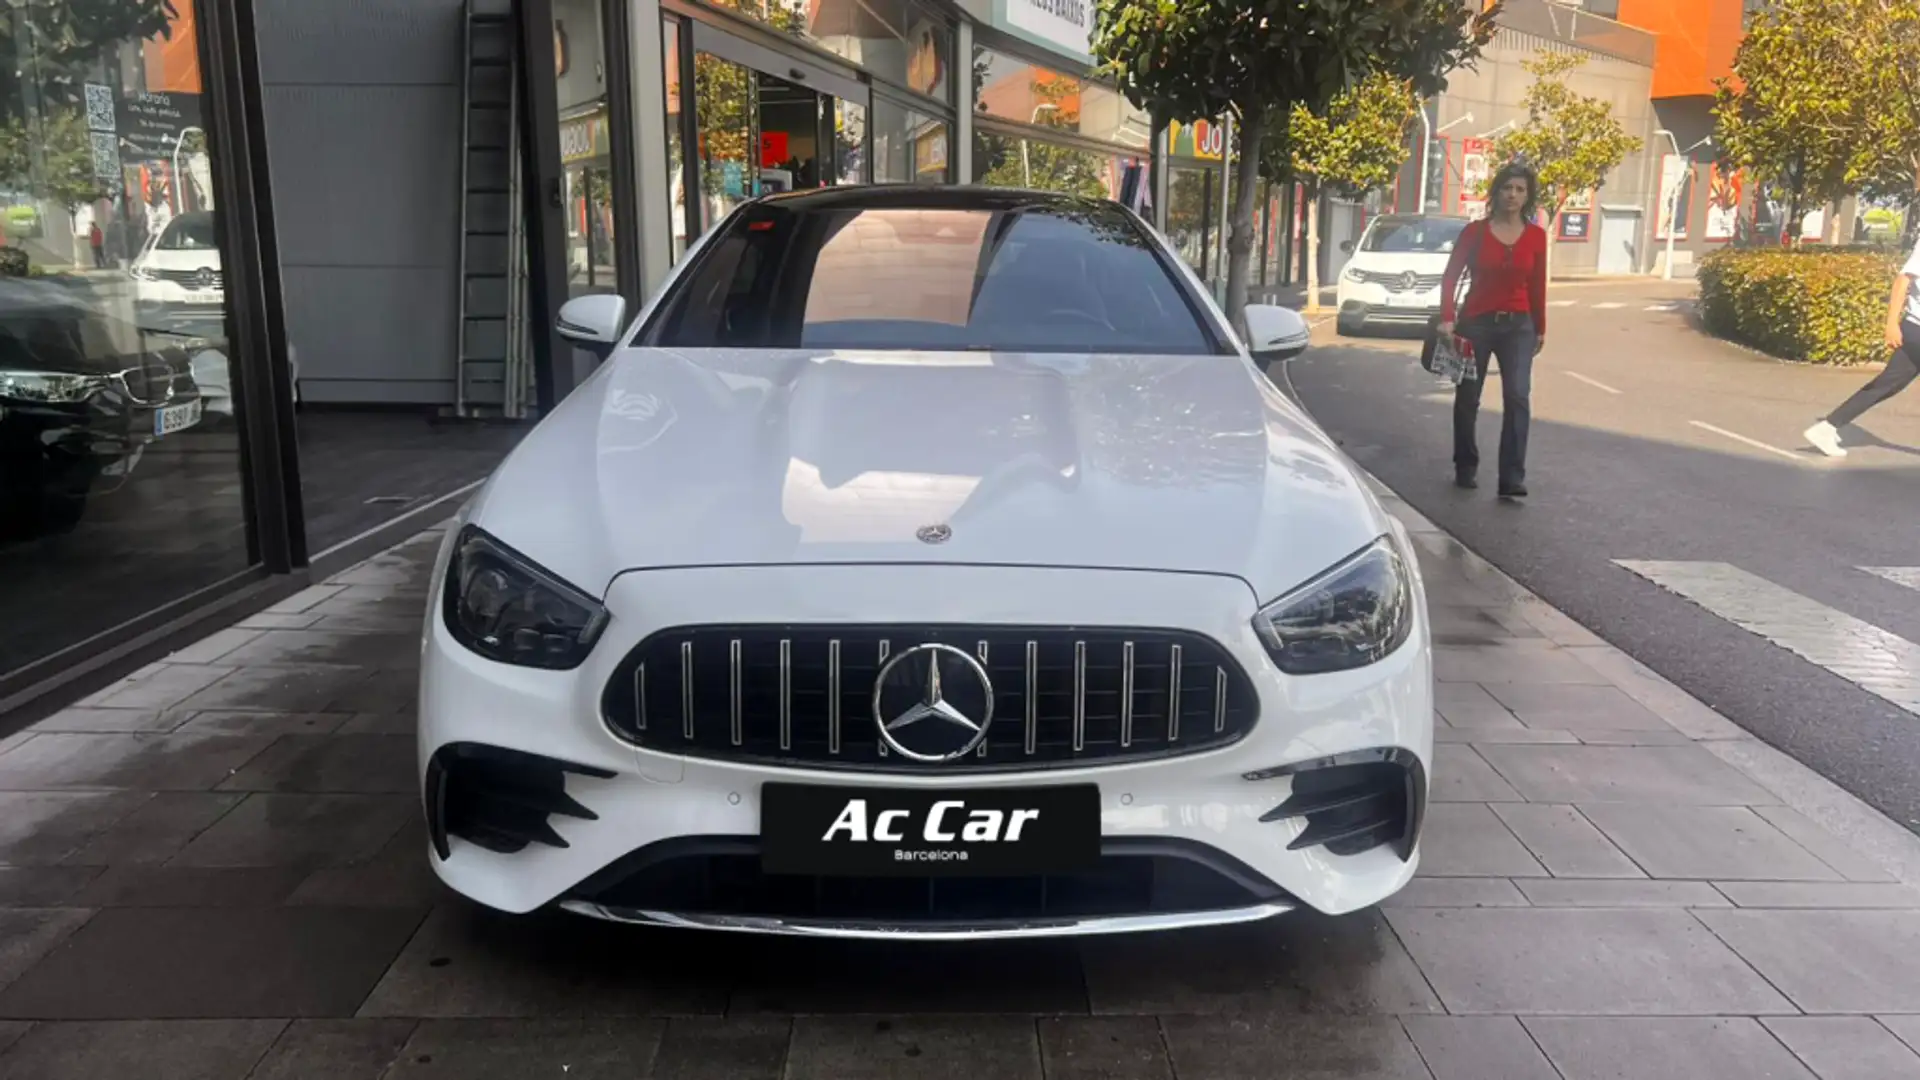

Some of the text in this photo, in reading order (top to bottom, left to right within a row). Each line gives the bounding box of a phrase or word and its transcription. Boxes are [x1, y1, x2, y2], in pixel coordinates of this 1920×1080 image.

[822, 799, 1039, 841] Ac Car
[895, 850, 968, 861] Barcelona
